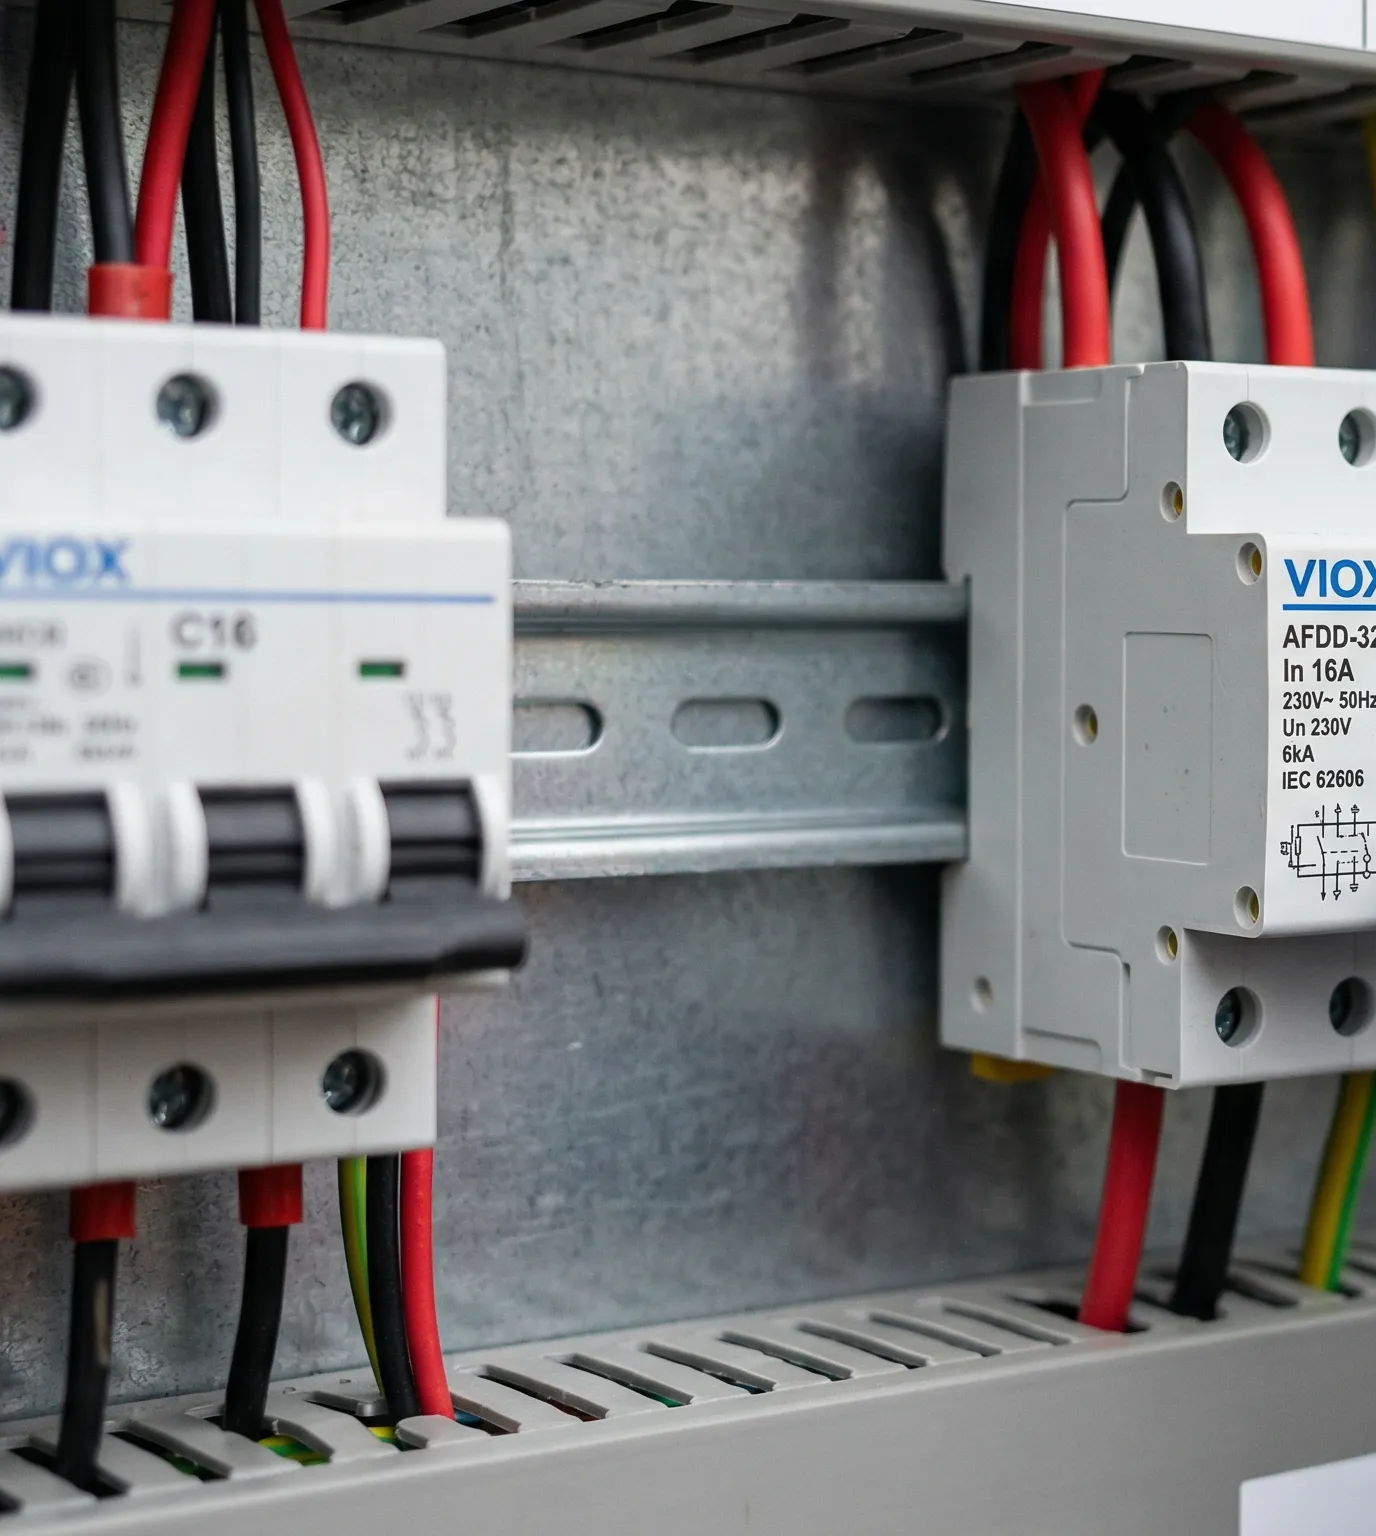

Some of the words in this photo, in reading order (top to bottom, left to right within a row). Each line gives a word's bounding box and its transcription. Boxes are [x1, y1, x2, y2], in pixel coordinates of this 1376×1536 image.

[170, 611, 257, 650] C16
[1283, 658, 1305, 682] In
[1312, 658, 1355, 682] 16A
[1282, 690, 1334, 710] 230V~
[1283, 718, 1306, 737] Un
[1310, 716, 1352, 737] 230V
[1282, 744, 1315, 764] 6kA
[1282, 770, 1311, 790] IEC
[1316, 769, 1365, 789] 62606
